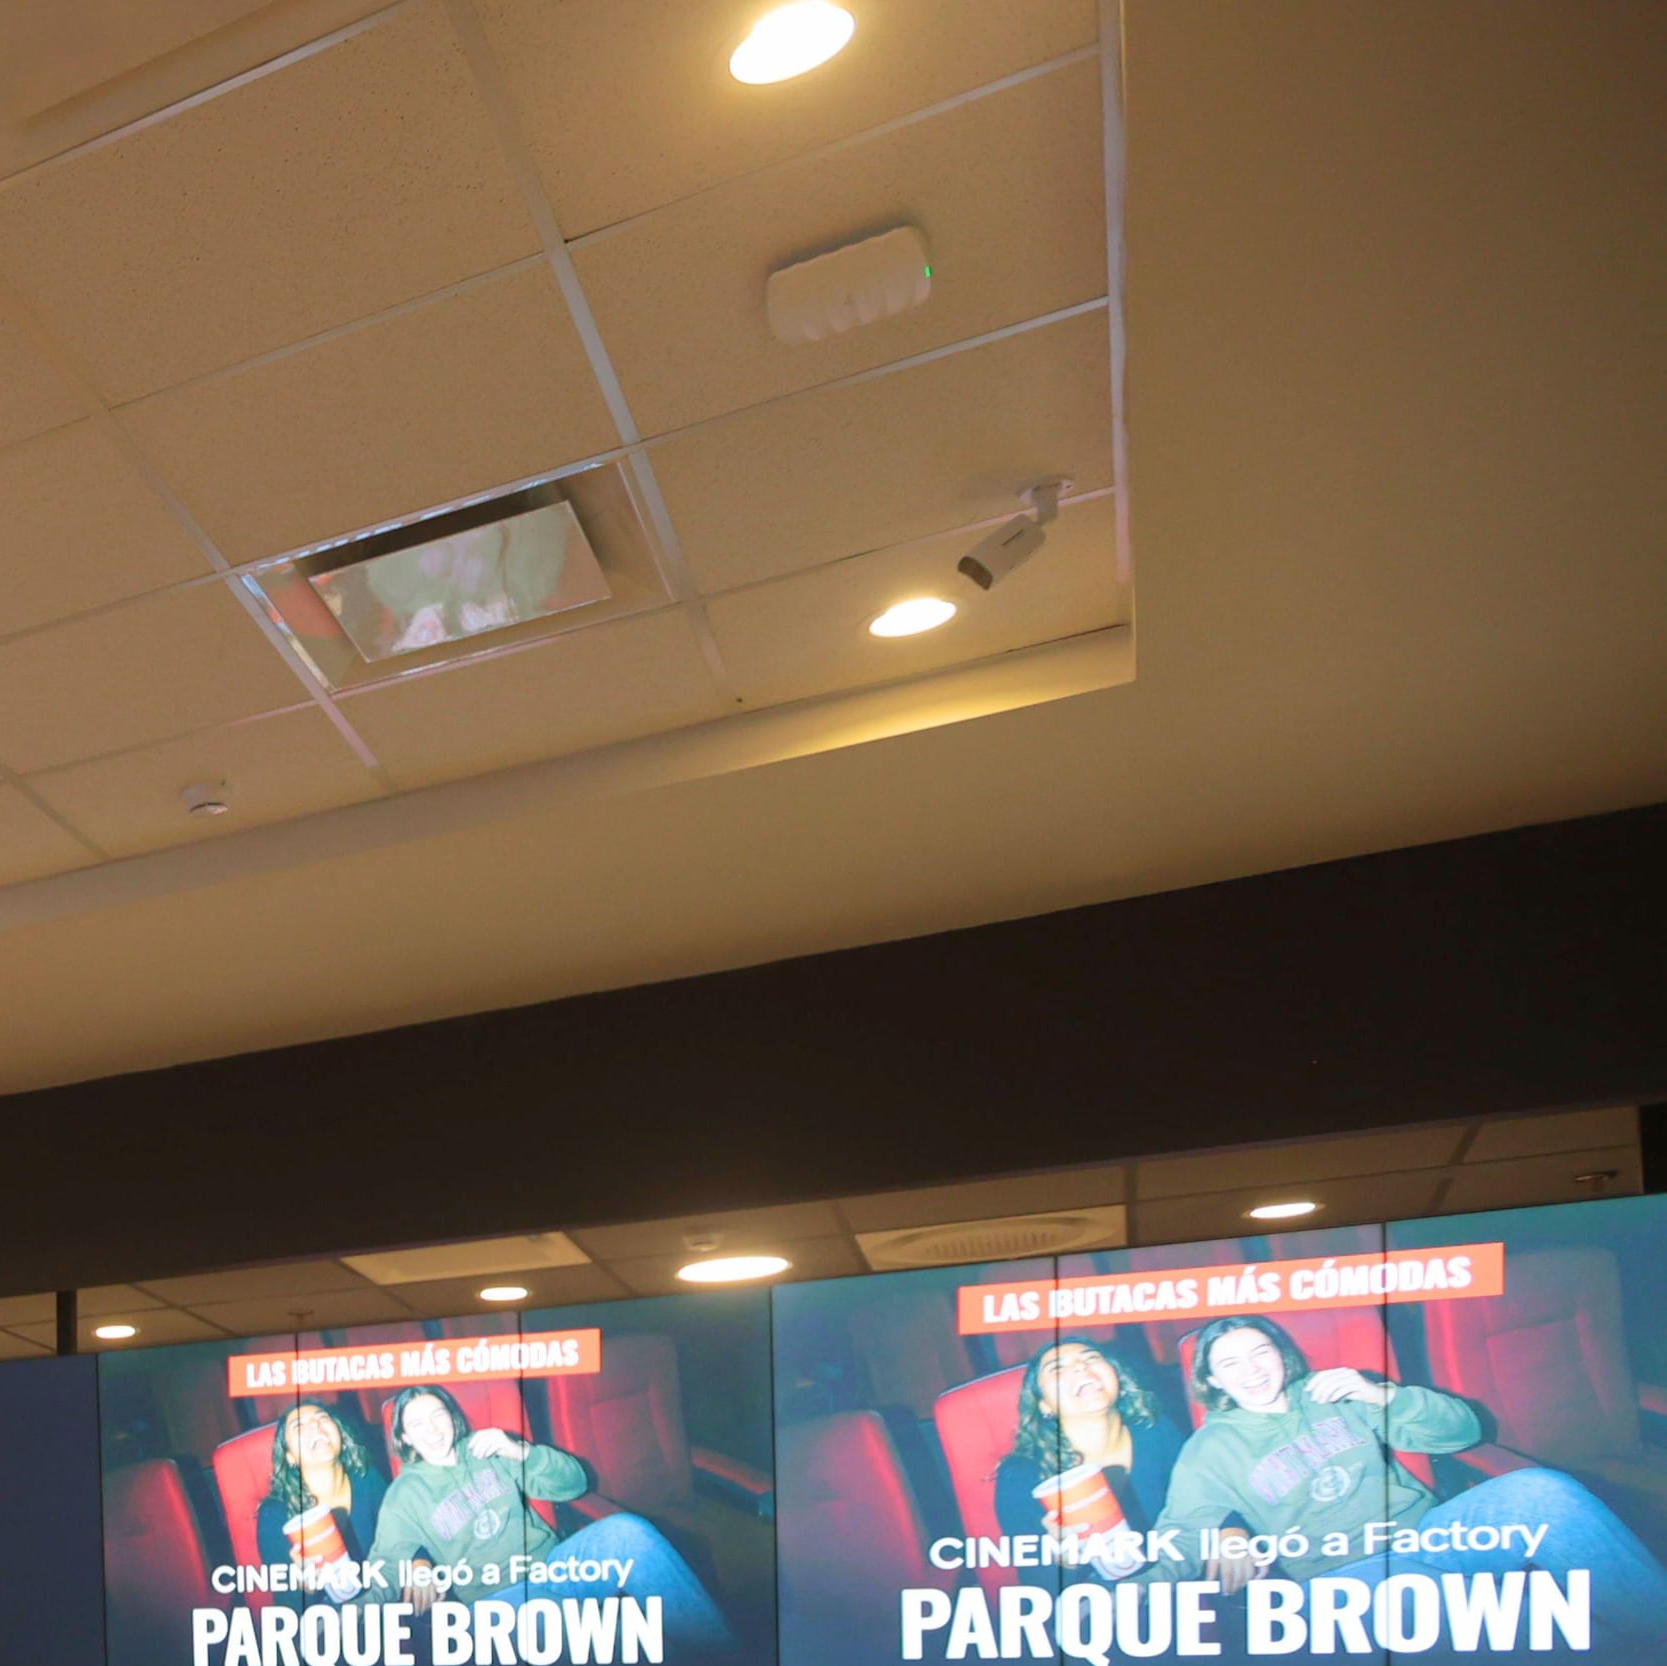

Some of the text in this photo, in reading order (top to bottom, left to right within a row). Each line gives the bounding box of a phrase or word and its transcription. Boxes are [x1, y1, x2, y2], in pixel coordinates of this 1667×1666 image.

[982, 1256, 1473, 1324] LAS BUTACAS MÁS CÓMODAS
[246, 1337, 579, 1388] LAS BUTACAS MÁS CÓMODAS
[929, 1520, 1549, 1571] CINEMARK llegó a Factory
[211, 1554, 633, 1594] CINEMARK llegó a Factory
[1246, 1569, 1590, 1655] BROWN
